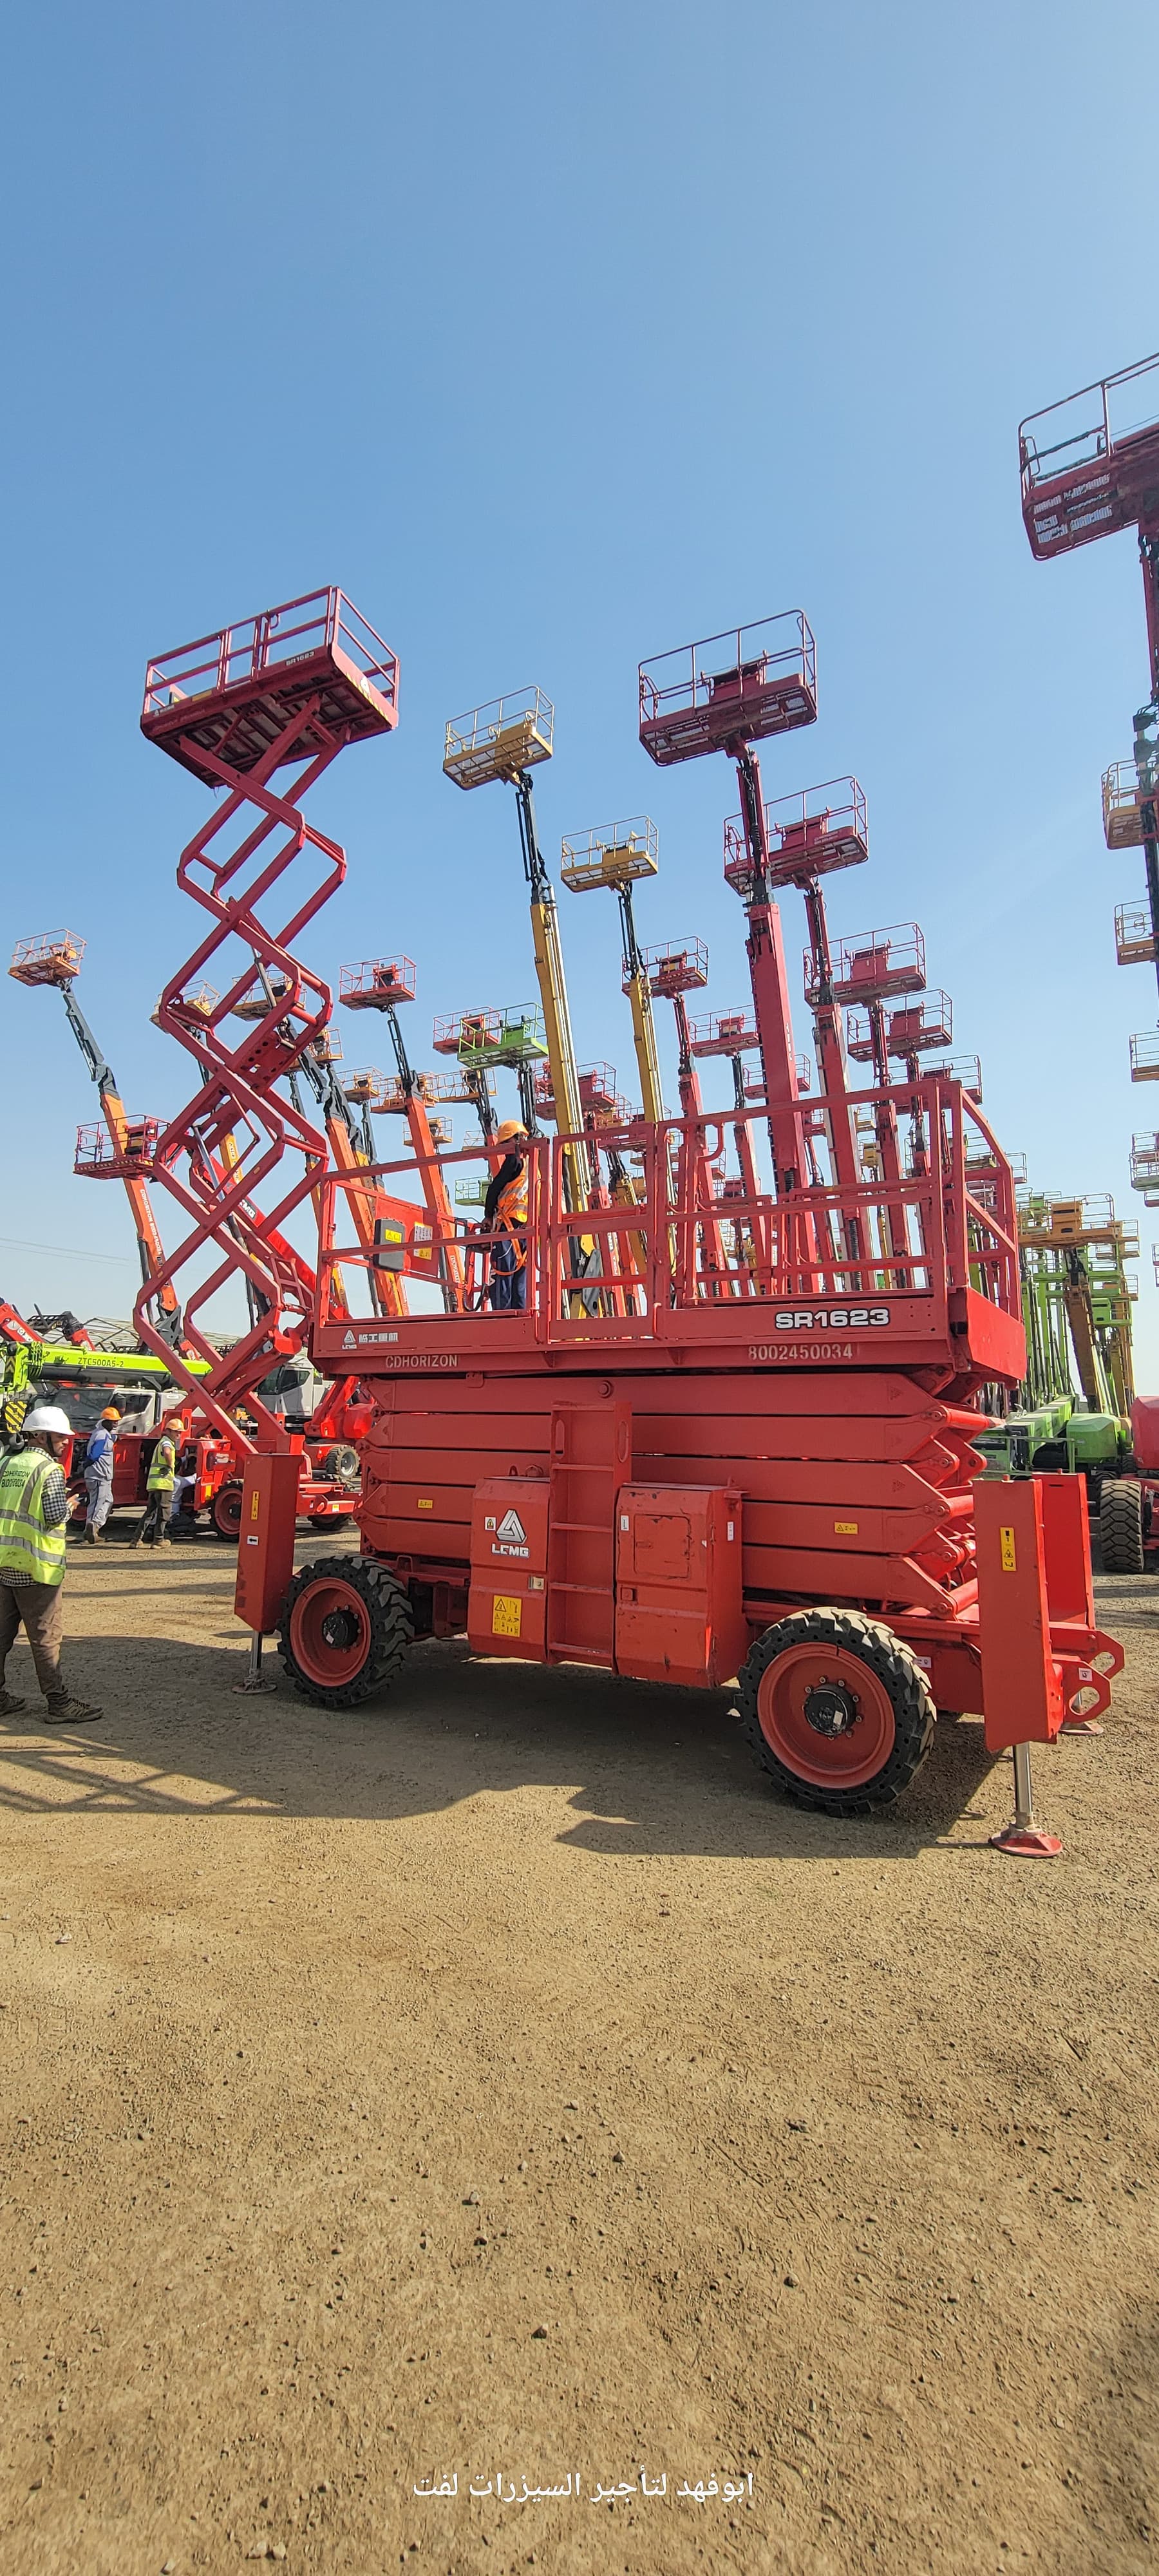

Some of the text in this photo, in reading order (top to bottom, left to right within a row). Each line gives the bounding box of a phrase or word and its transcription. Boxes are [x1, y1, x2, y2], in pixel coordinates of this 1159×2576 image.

[775, 1309, 889, 1329] SR1623
[748, 1343, 853, 1360] 8002450034
[386, 1355, 457, 1368] CDHORIZON
